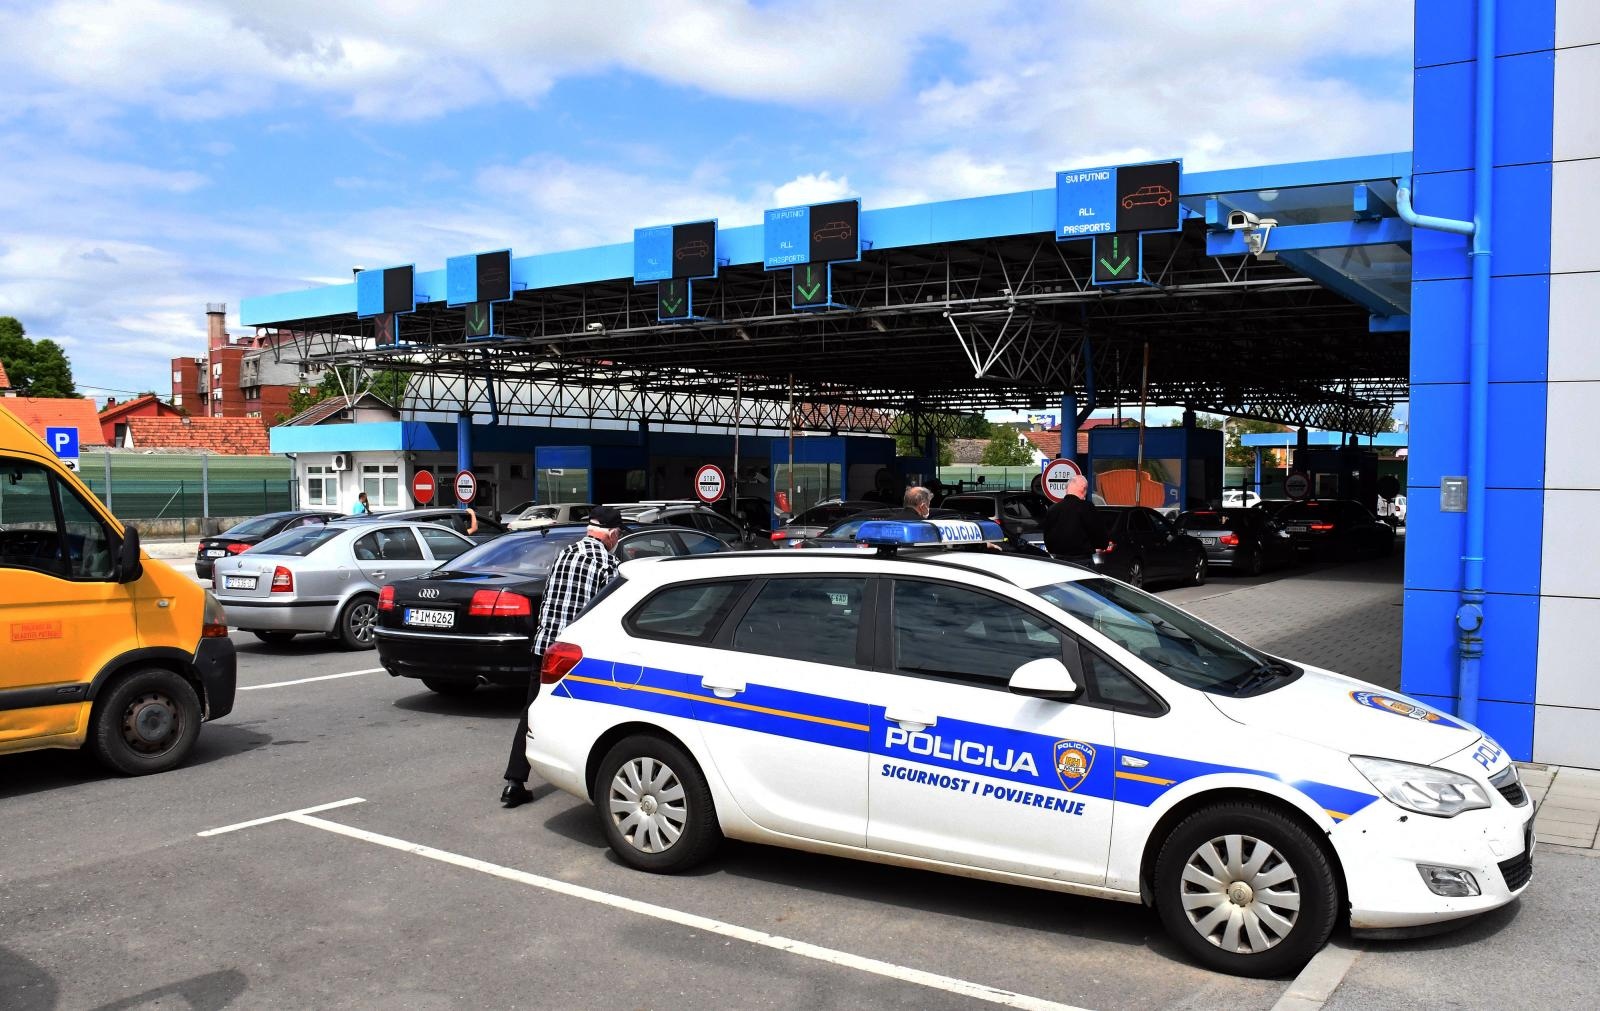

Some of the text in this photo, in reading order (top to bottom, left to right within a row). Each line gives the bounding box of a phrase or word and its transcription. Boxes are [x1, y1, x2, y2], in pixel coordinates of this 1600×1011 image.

[1065, 172, 1109, 183] SVI PUTNICI
[1079, 208, 1095, 216] ALL
[1063, 223, 1110, 234] PASSPORTS
[780, 241, 793, 249] ALL
[55, 432, 70, 453] P
[939, 523, 981, 540] POLICIJA
[410, 610, 416, 621] F
[431, 612, 453, 625] 6262
[885, 727, 1038, 776] POLICIJA
[1057, 742, 1093, 756] POLICIJA
[882, 764, 1085, 815] SIGURNOST I POVJERENJE
